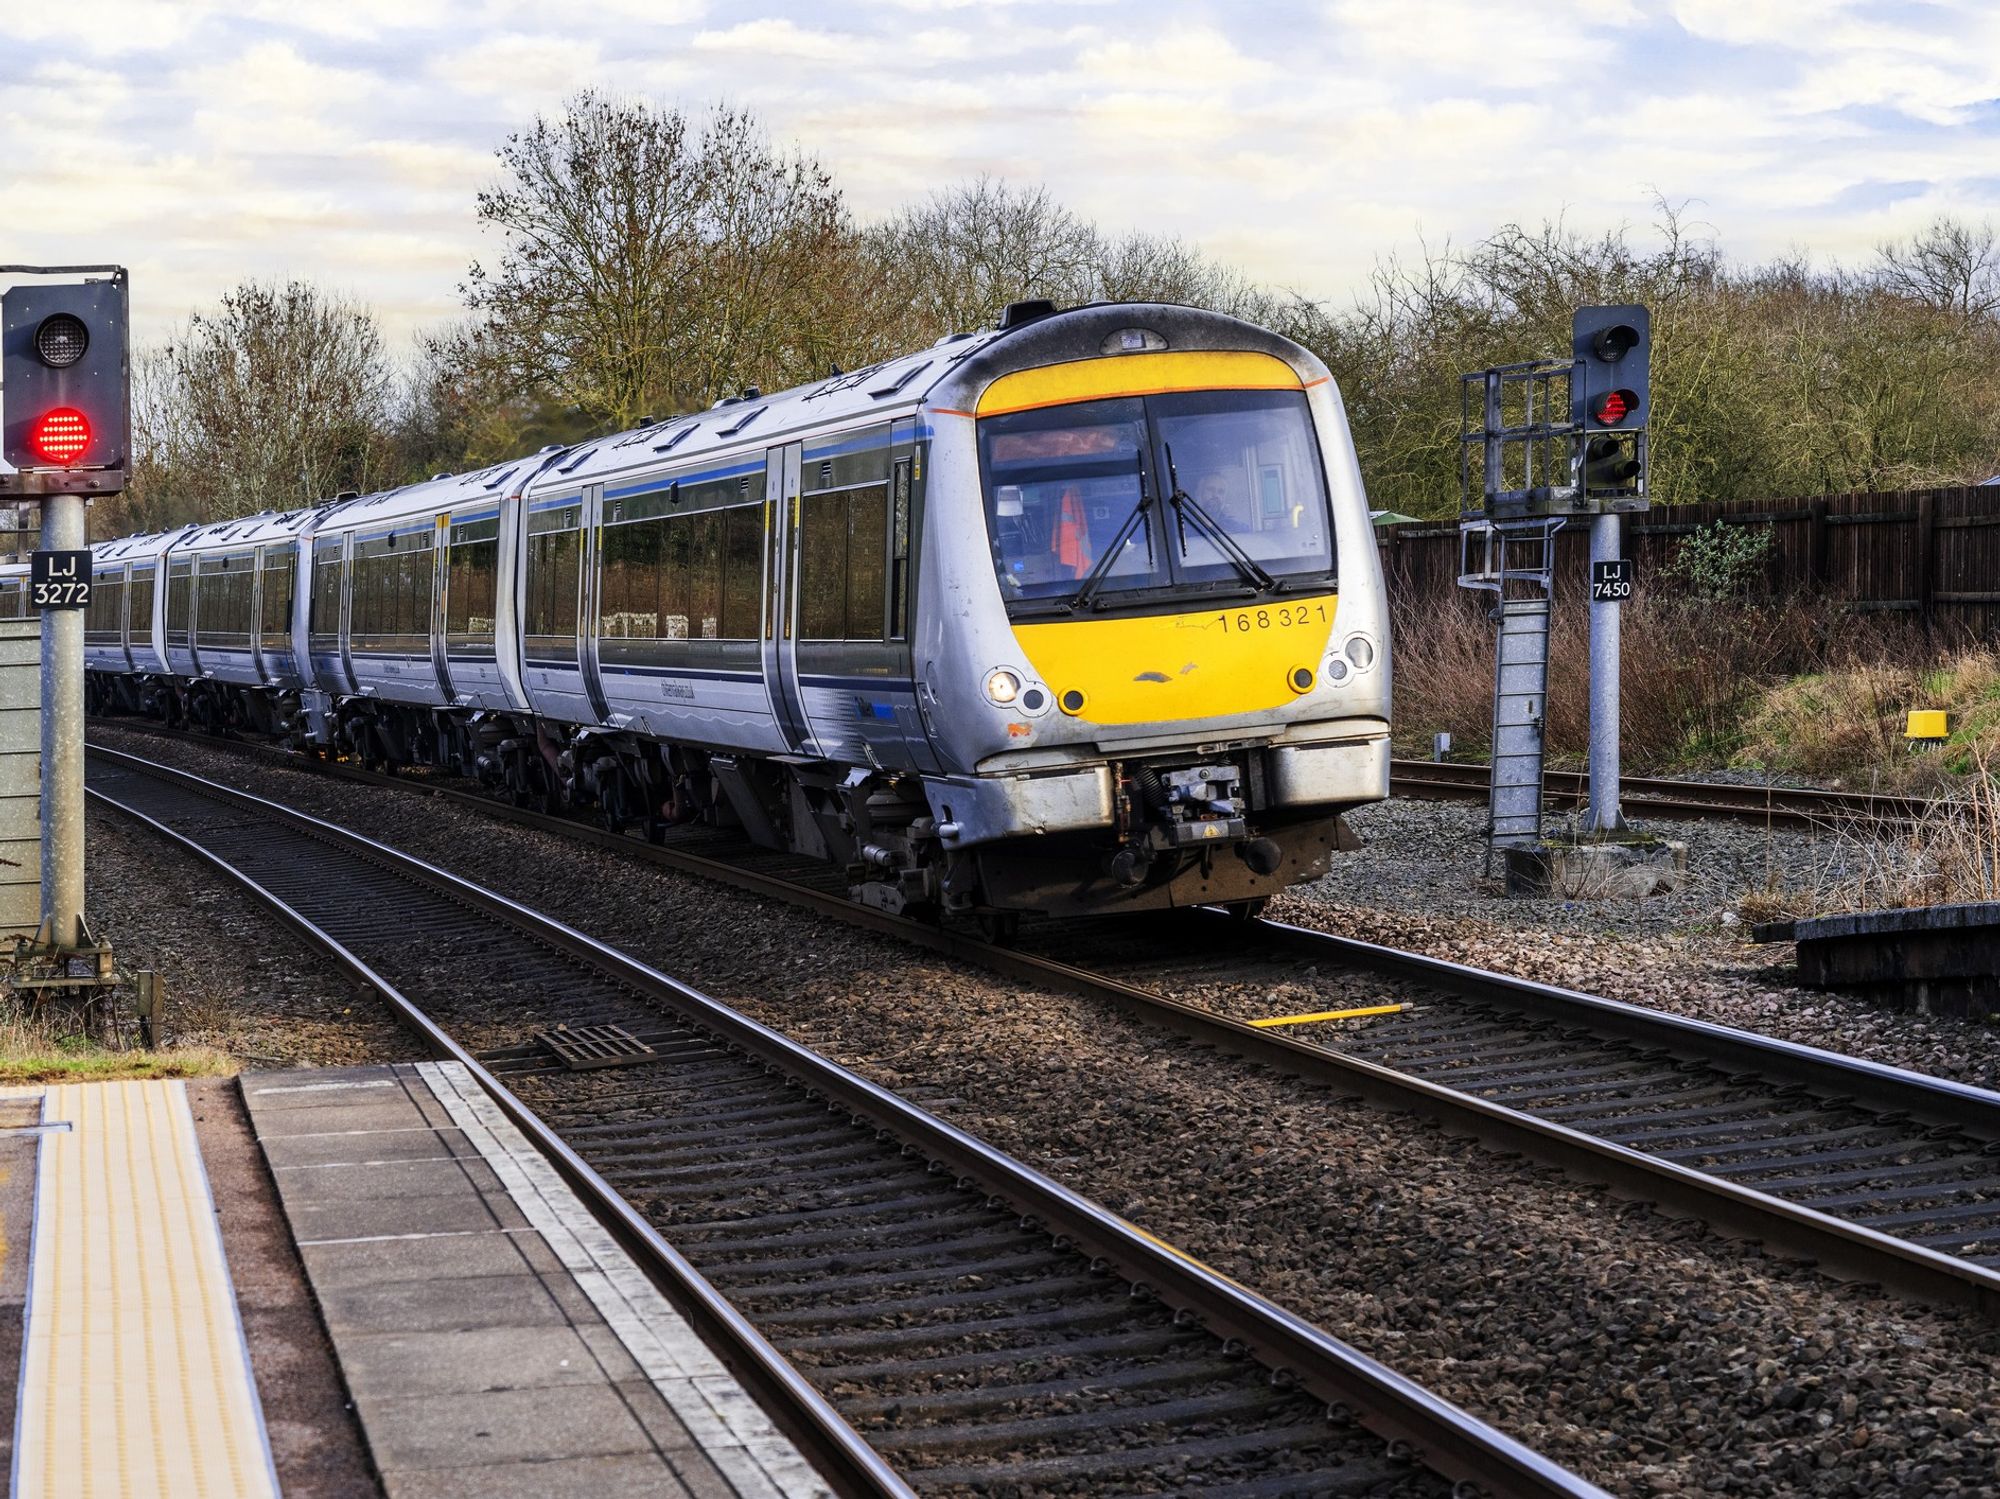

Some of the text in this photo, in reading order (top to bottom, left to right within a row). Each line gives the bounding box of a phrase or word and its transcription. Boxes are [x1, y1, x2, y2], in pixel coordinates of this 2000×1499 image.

[48, 556, 76, 577] LJ
[1603, 564, 1621, 579] LJ
[34, 582, 89, 604] 3272
[1593, 582, 1630, 598] 7450
[1218, 605, 1326, 633] 168321
